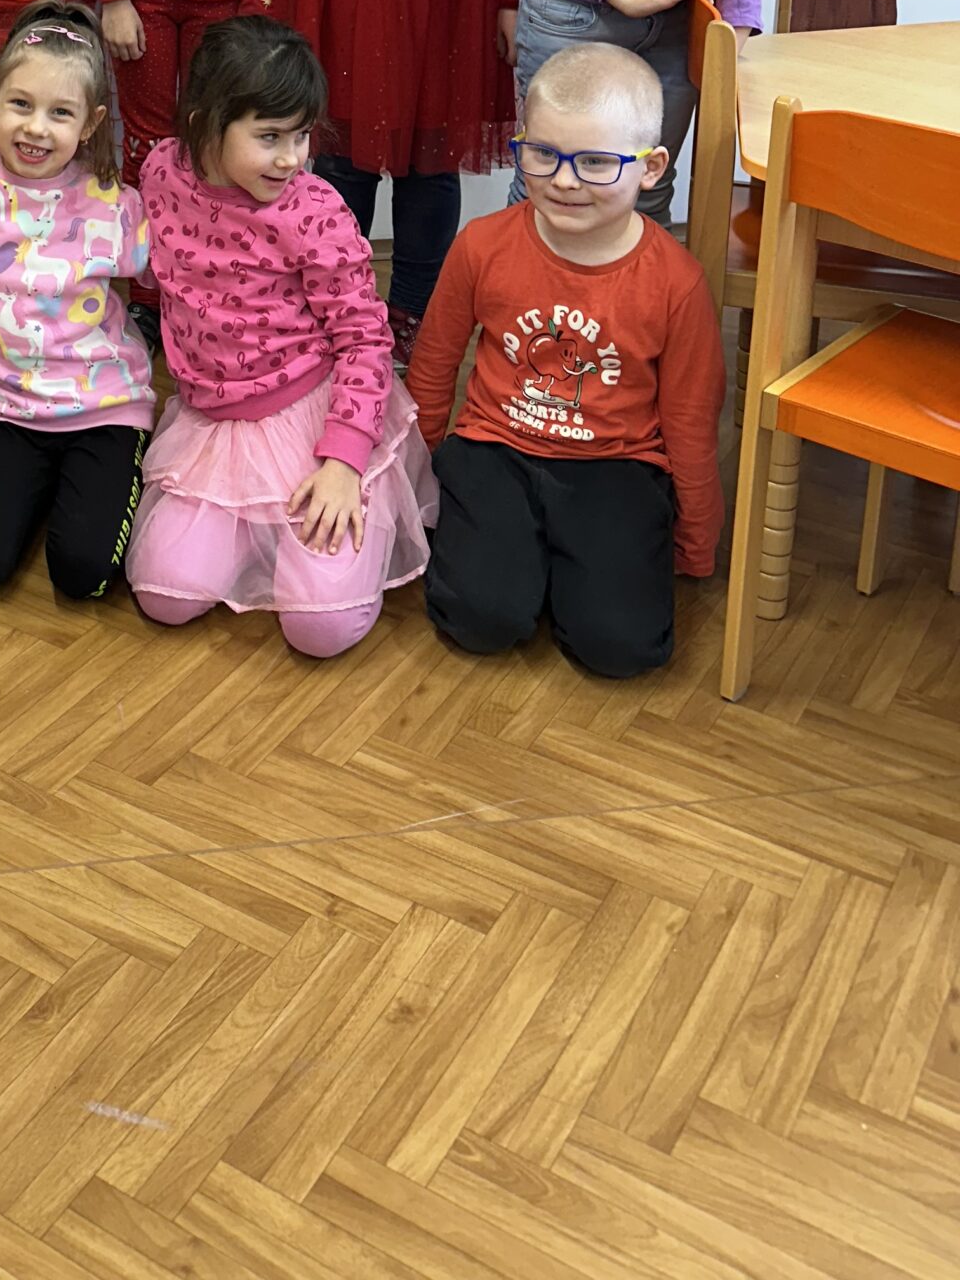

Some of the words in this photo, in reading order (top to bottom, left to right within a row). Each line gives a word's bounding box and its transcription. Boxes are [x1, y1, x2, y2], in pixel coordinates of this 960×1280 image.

[516, 308, 544, 336] IT
[552, 304, 602, 344] FOR
[596, 342, 622, 386] YOU
[500, 403, 546, 431] FRESH
[548, 424, 595, 442] FOOD
[510, 396, 568, 423] SPORTS
[572, 412, 584, 426] &
[111, 518, 131, 566] GIRL
